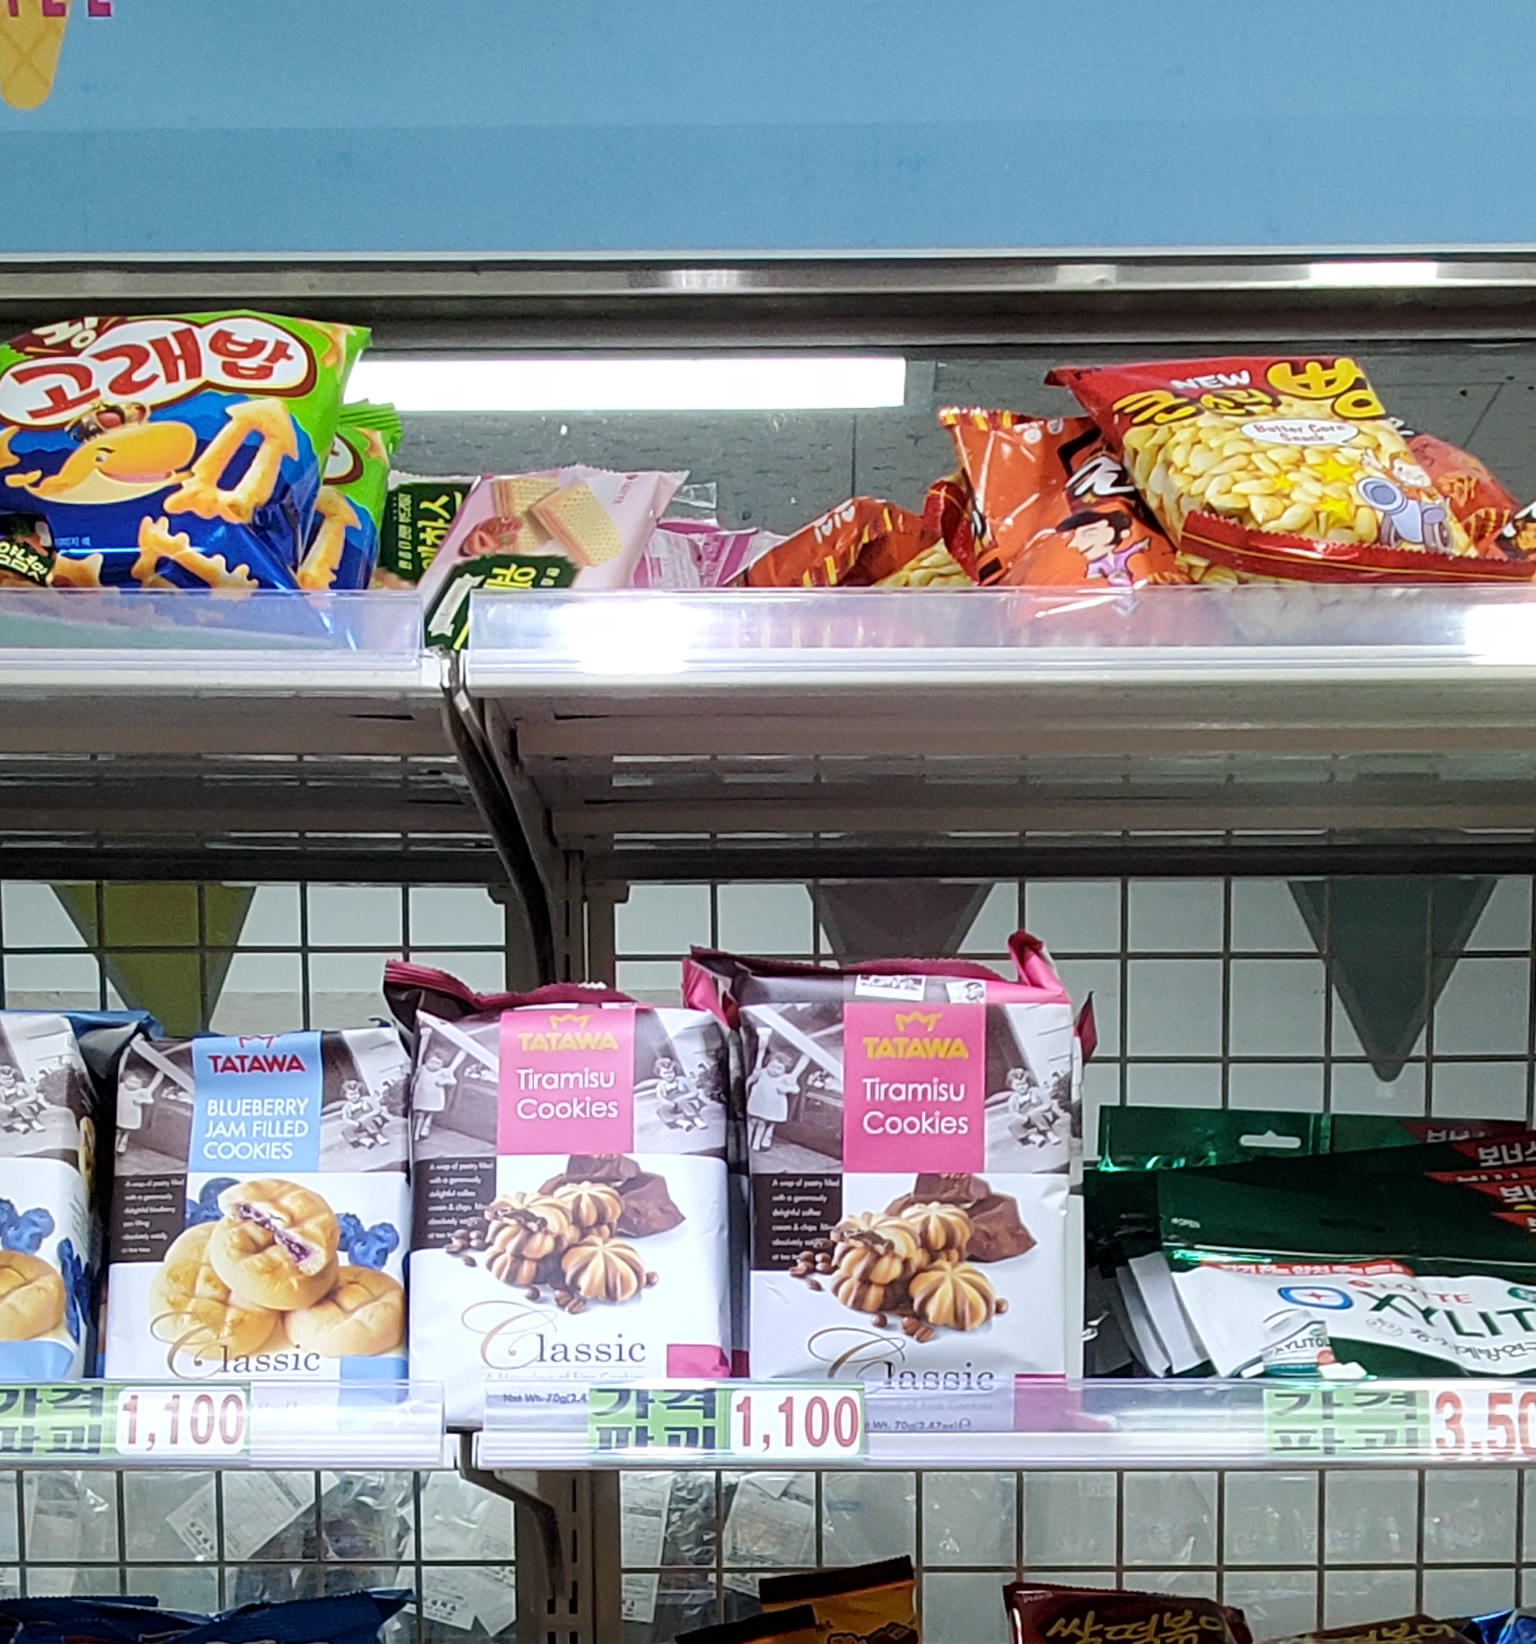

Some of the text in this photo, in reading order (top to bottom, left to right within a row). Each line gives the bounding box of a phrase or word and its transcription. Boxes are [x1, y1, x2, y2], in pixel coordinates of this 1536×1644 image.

[6, 321, 296, 413] 고래밥
[1172, 370, 1250, 390] NEW
[517, 1031, 619, 1053] TATAWA
[862, 1036, 969, 1060] TATAWA
[207, 1054, 307, 1075] TATAWA
[516, 1066, 616, 1092] Tiramisu
[862, 1077, 966, 1103] Tiramisu
[207, 1096, 309, 1119] BLUEBERRY
[516, 1097, 619, 1121] Cookies
[203, 1119, 309, 1140] JAM FILLED
[862, 1111, 969, 1136] Cookies
[203, 1140, 295, 1160] COOKIES
[150, 1312, 321, 1379] Classic
[462, 1300, 647, 1368] Classic
[807, 1326, 995, 1394] Classic
[591, 1388, 716, 1421] 가격
[1273, 1391, 1416, 1421] 가격
[122, 1394, 243, 1451] 1,100
[733, 1394, 861, 1453] 1,100
